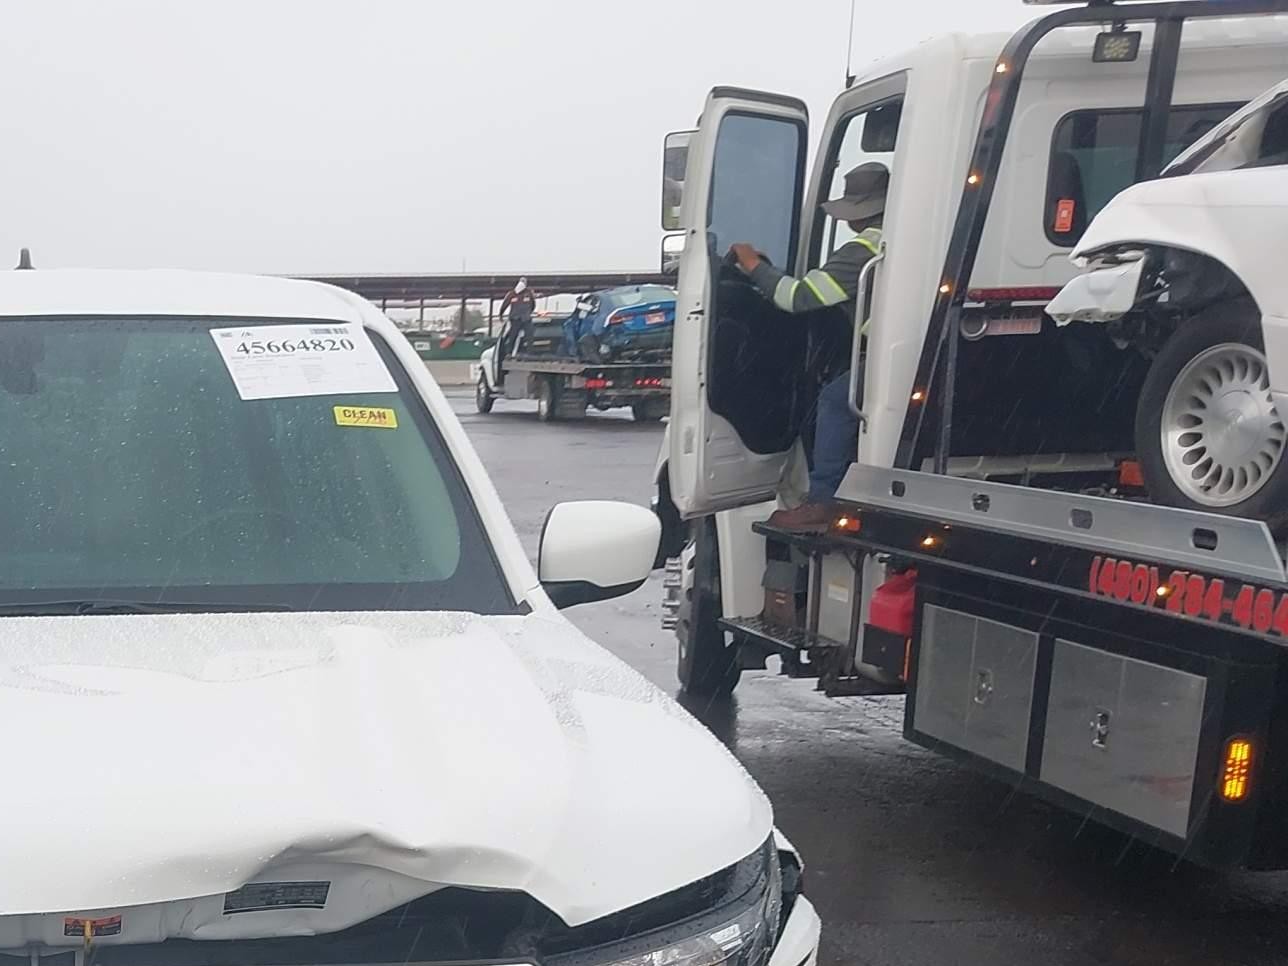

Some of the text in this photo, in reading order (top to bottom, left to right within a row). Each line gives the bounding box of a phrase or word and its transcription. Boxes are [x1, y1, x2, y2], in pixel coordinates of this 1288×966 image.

[236, 338, 355, 355] 45664820
[342, 408, 387, 420] CLEAN
[1089, 555, 1159, 607] (480)
